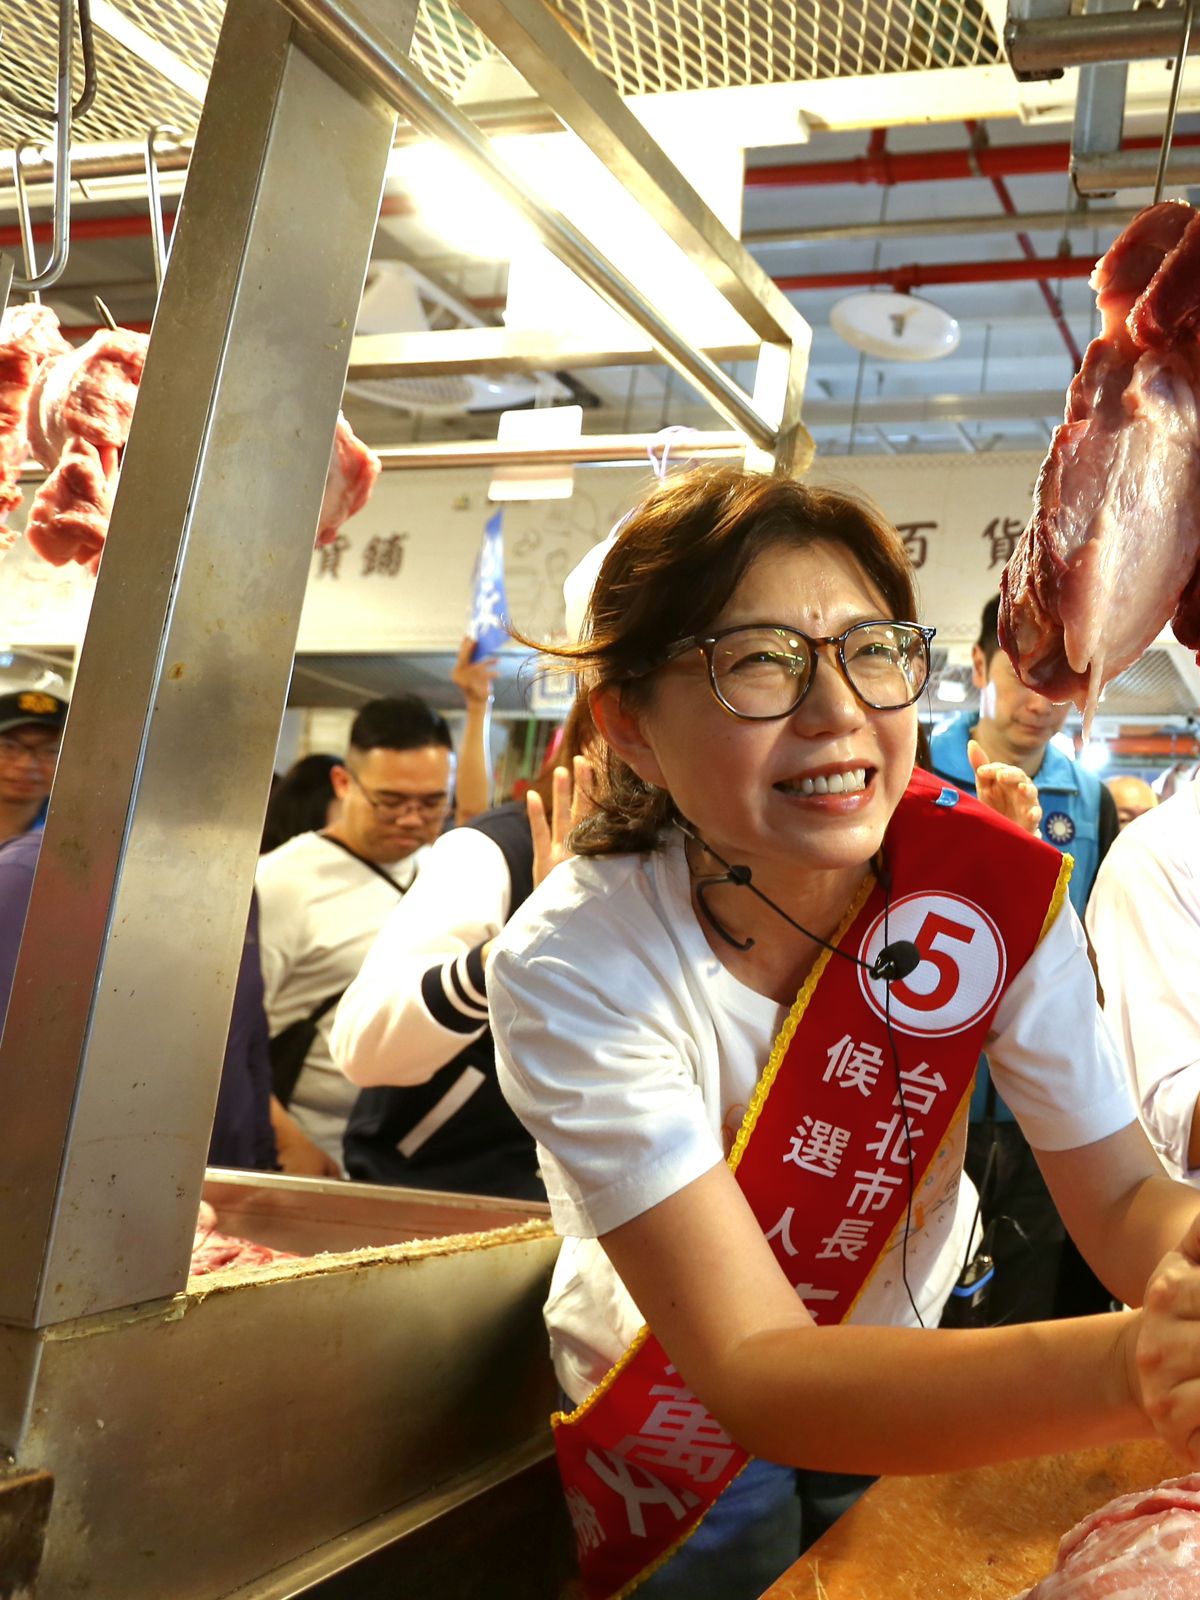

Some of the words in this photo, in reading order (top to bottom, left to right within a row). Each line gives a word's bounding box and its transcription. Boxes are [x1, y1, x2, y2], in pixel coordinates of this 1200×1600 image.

[887, 911, 976, 1012] 5
[765, 1034, 884, 1257] 候選人
[815, 1061, 947, 1262] 台北市長
